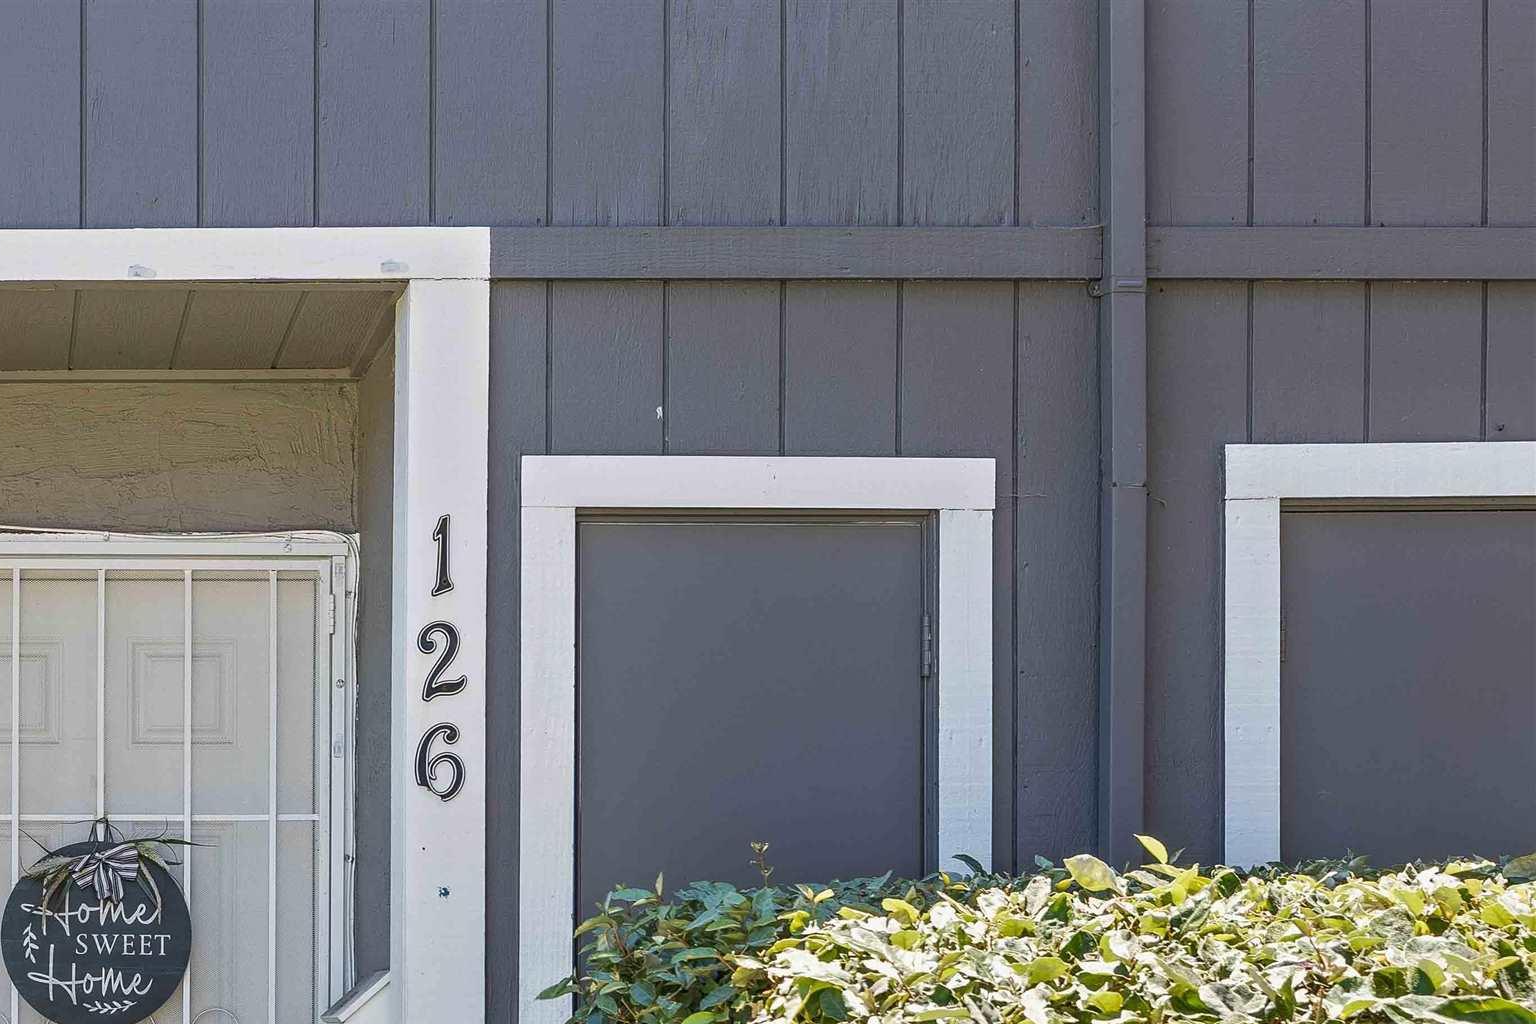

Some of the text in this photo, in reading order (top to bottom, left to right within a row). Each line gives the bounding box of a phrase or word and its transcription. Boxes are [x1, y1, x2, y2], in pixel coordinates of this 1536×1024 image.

[414, 513, 468, 803] 126
[20, 880, 159, 937] Home
[27, 943, 154, 1006] Home
[75, 933, 172, 957] SWEET
